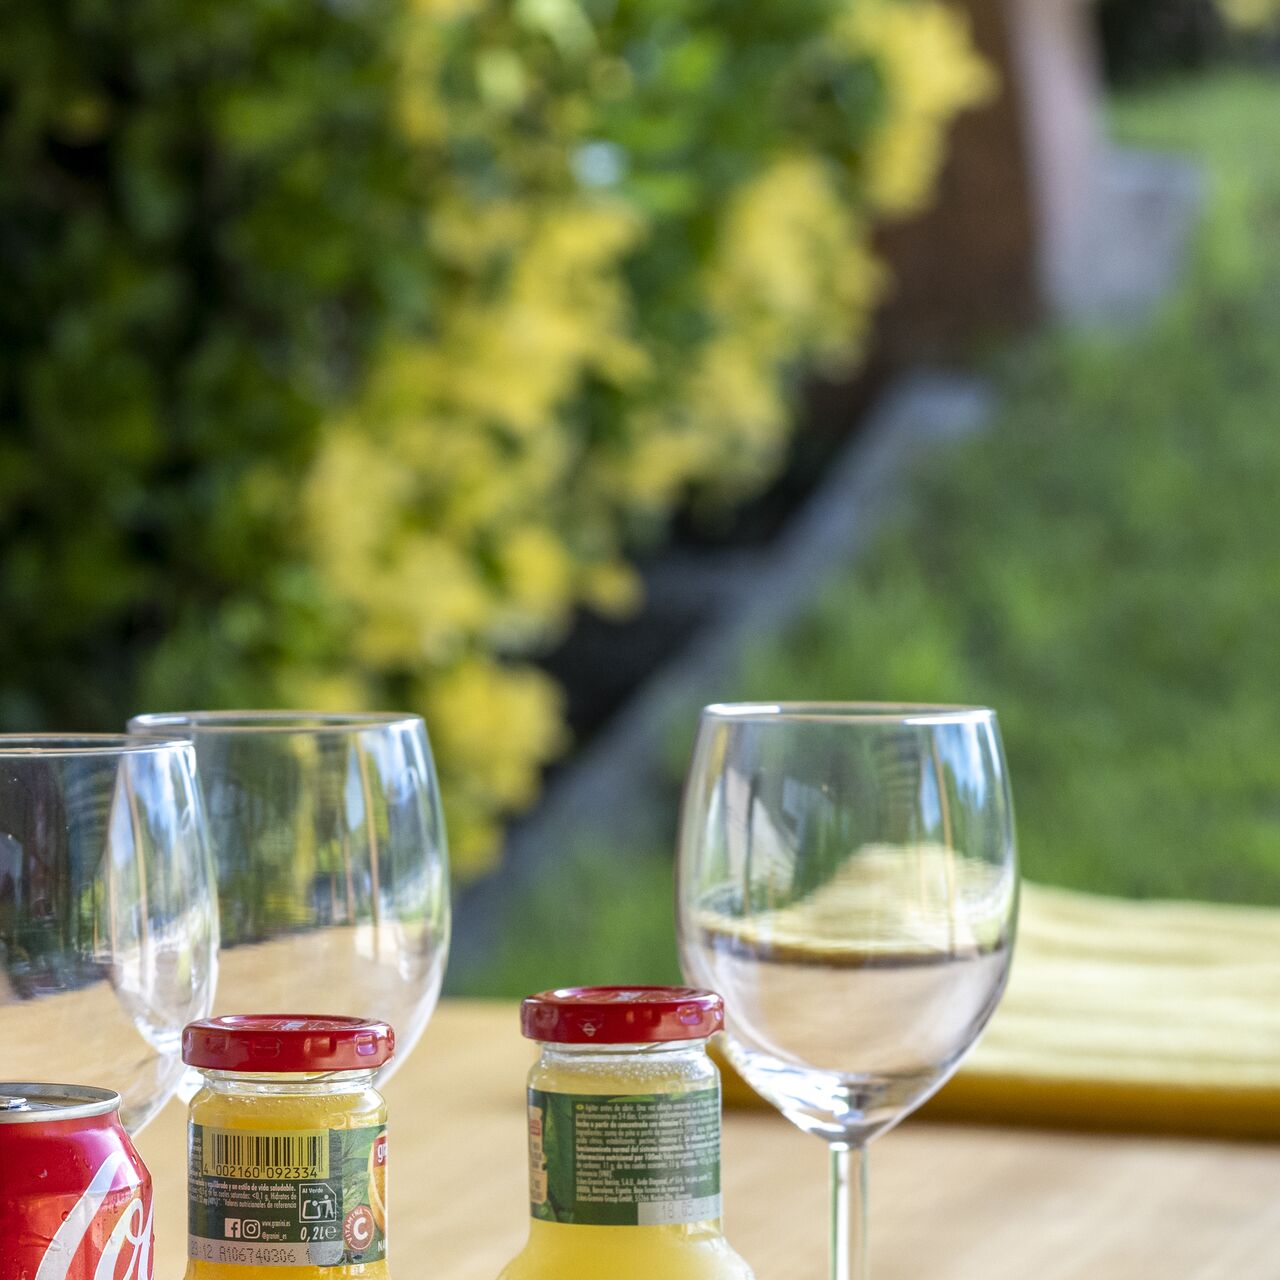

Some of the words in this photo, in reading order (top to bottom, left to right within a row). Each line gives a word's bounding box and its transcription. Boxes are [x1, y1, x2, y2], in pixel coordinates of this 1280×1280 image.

[216, 1164, 260, 1178] 002160
[266, 1167, 318, 1179] 092334
[353, 1216, 369, 1240] C
